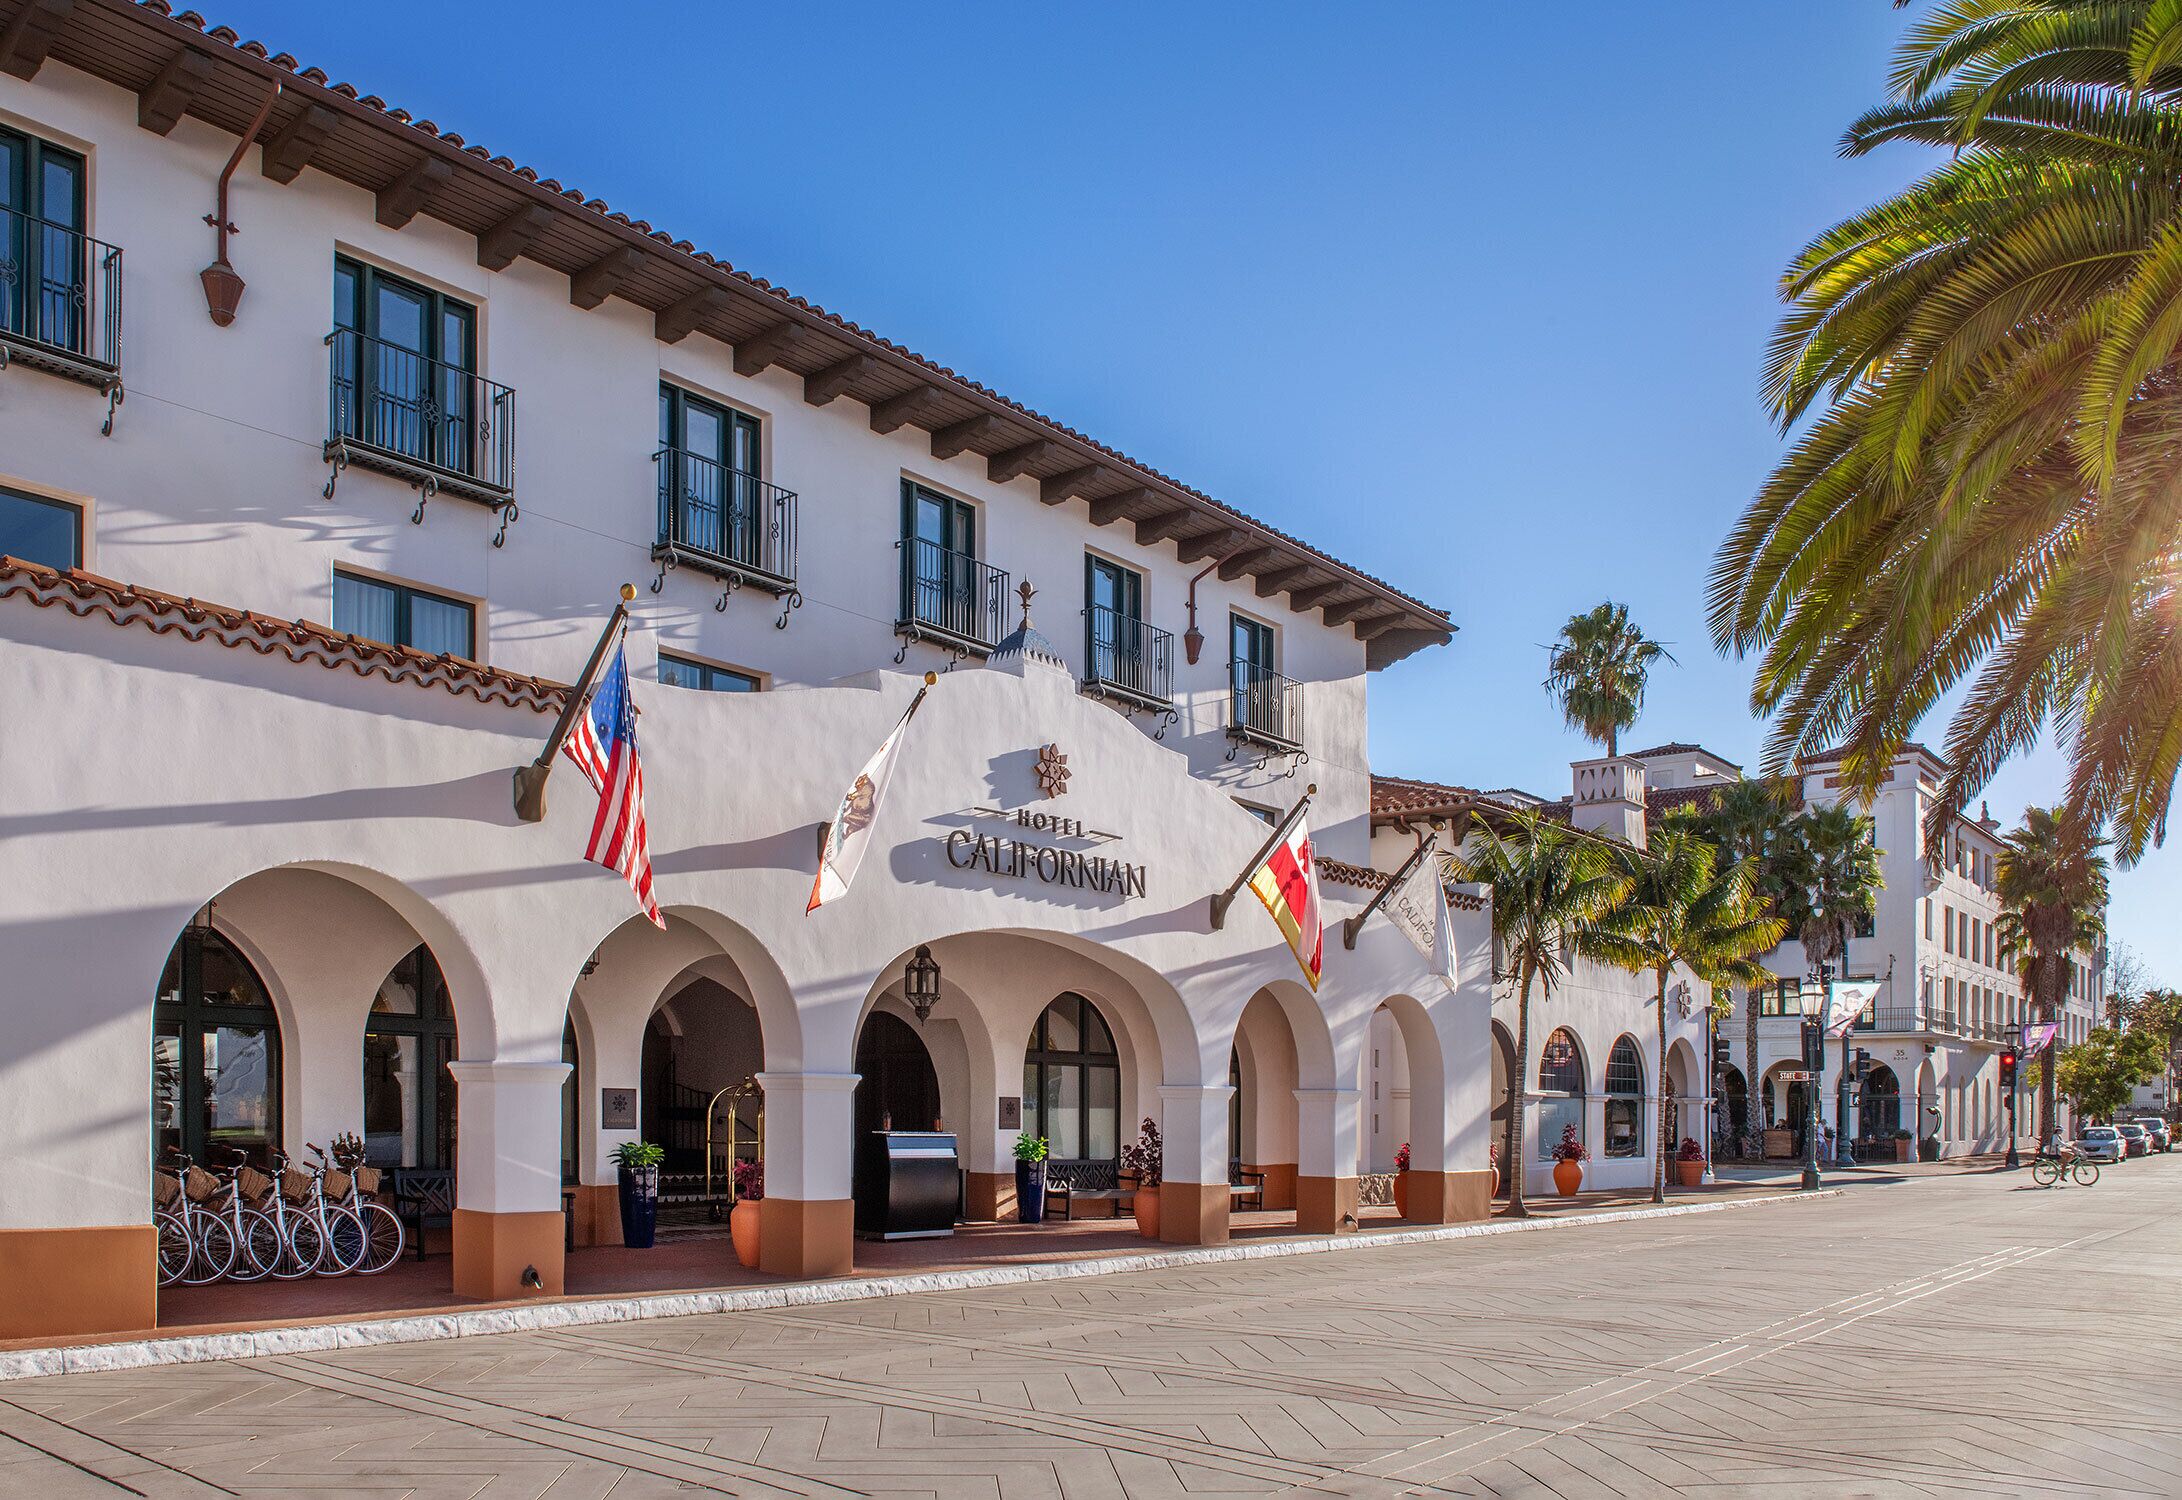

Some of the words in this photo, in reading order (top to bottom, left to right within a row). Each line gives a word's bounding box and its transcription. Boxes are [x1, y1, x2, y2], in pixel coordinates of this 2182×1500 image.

[1017, 808, 1085, 838] HOTEL
[947, 829, 1147, 899] CALIFORNIAN
[1398, 897, 1434, 948] CALIFO
